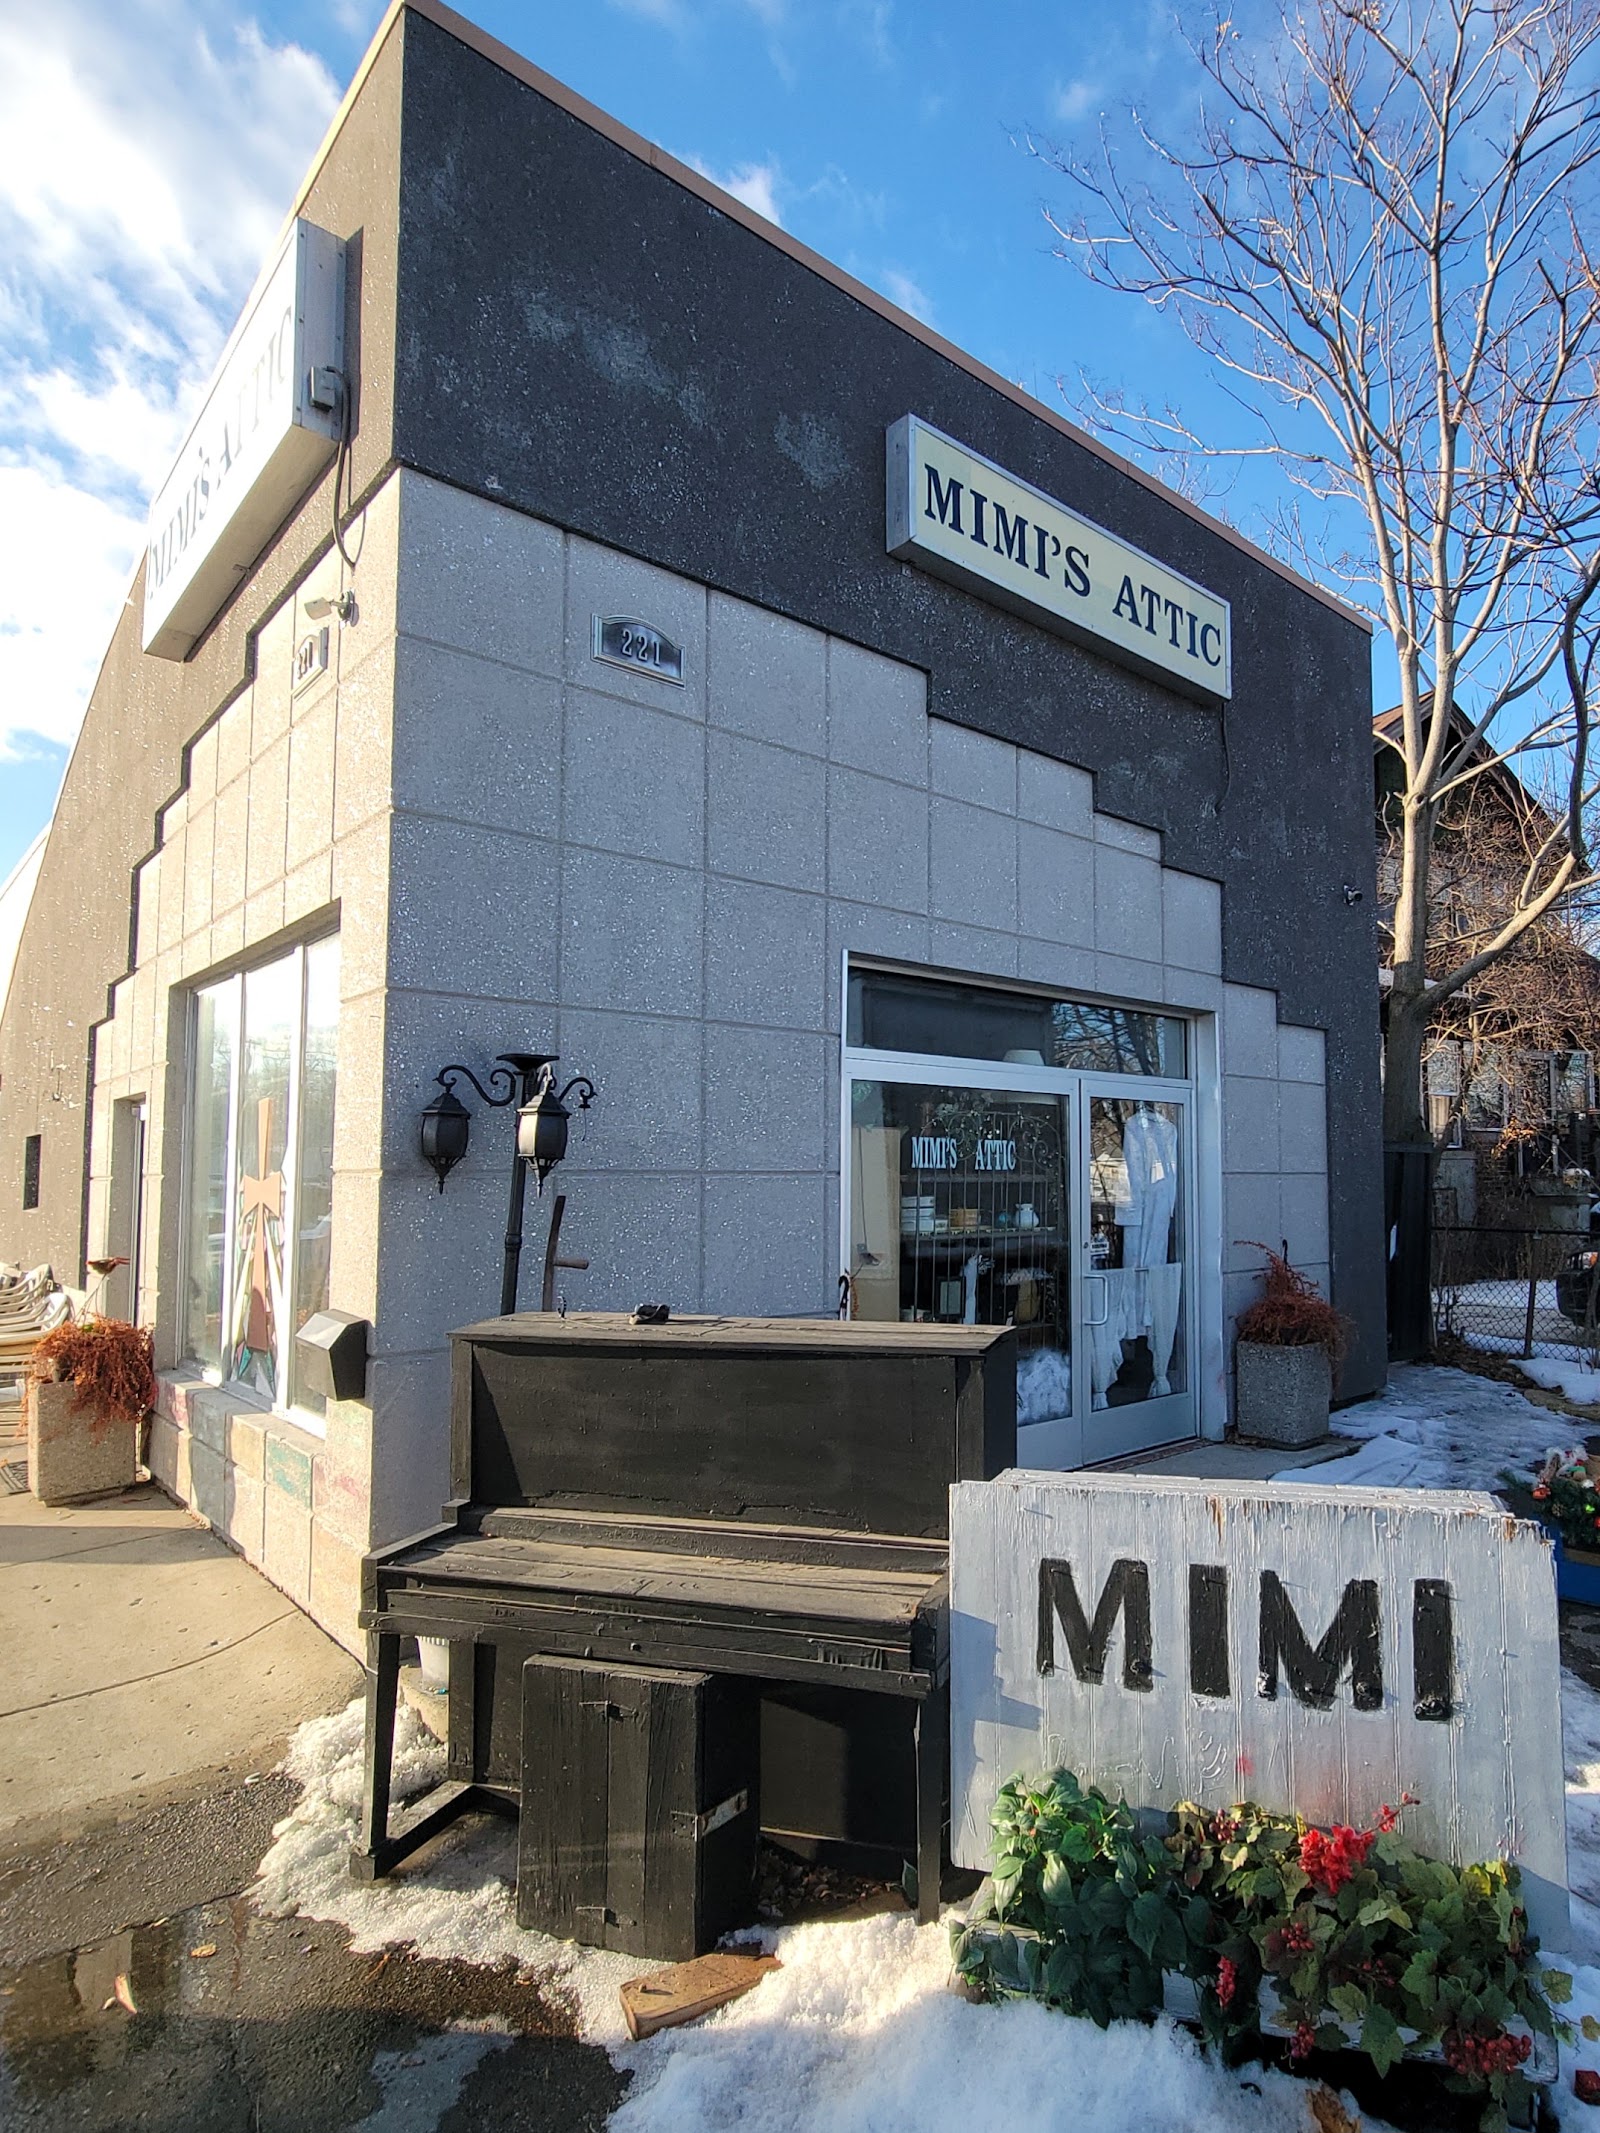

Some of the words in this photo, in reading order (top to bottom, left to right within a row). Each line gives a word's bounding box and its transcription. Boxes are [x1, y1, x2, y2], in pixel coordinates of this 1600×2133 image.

[147, 445, 210, 600] MIMI'S
[924, 463, 1091, 598] MIMI'S
[1112, 574, 1221, 667] ATTIC
[621, 628, 661, 667] 221
[911, 1136, 957, 1169] MIMI'S
[975, 1139, 1017, 1170] ATTIC
[1036, 1557, 1453, 1722] MIMI
